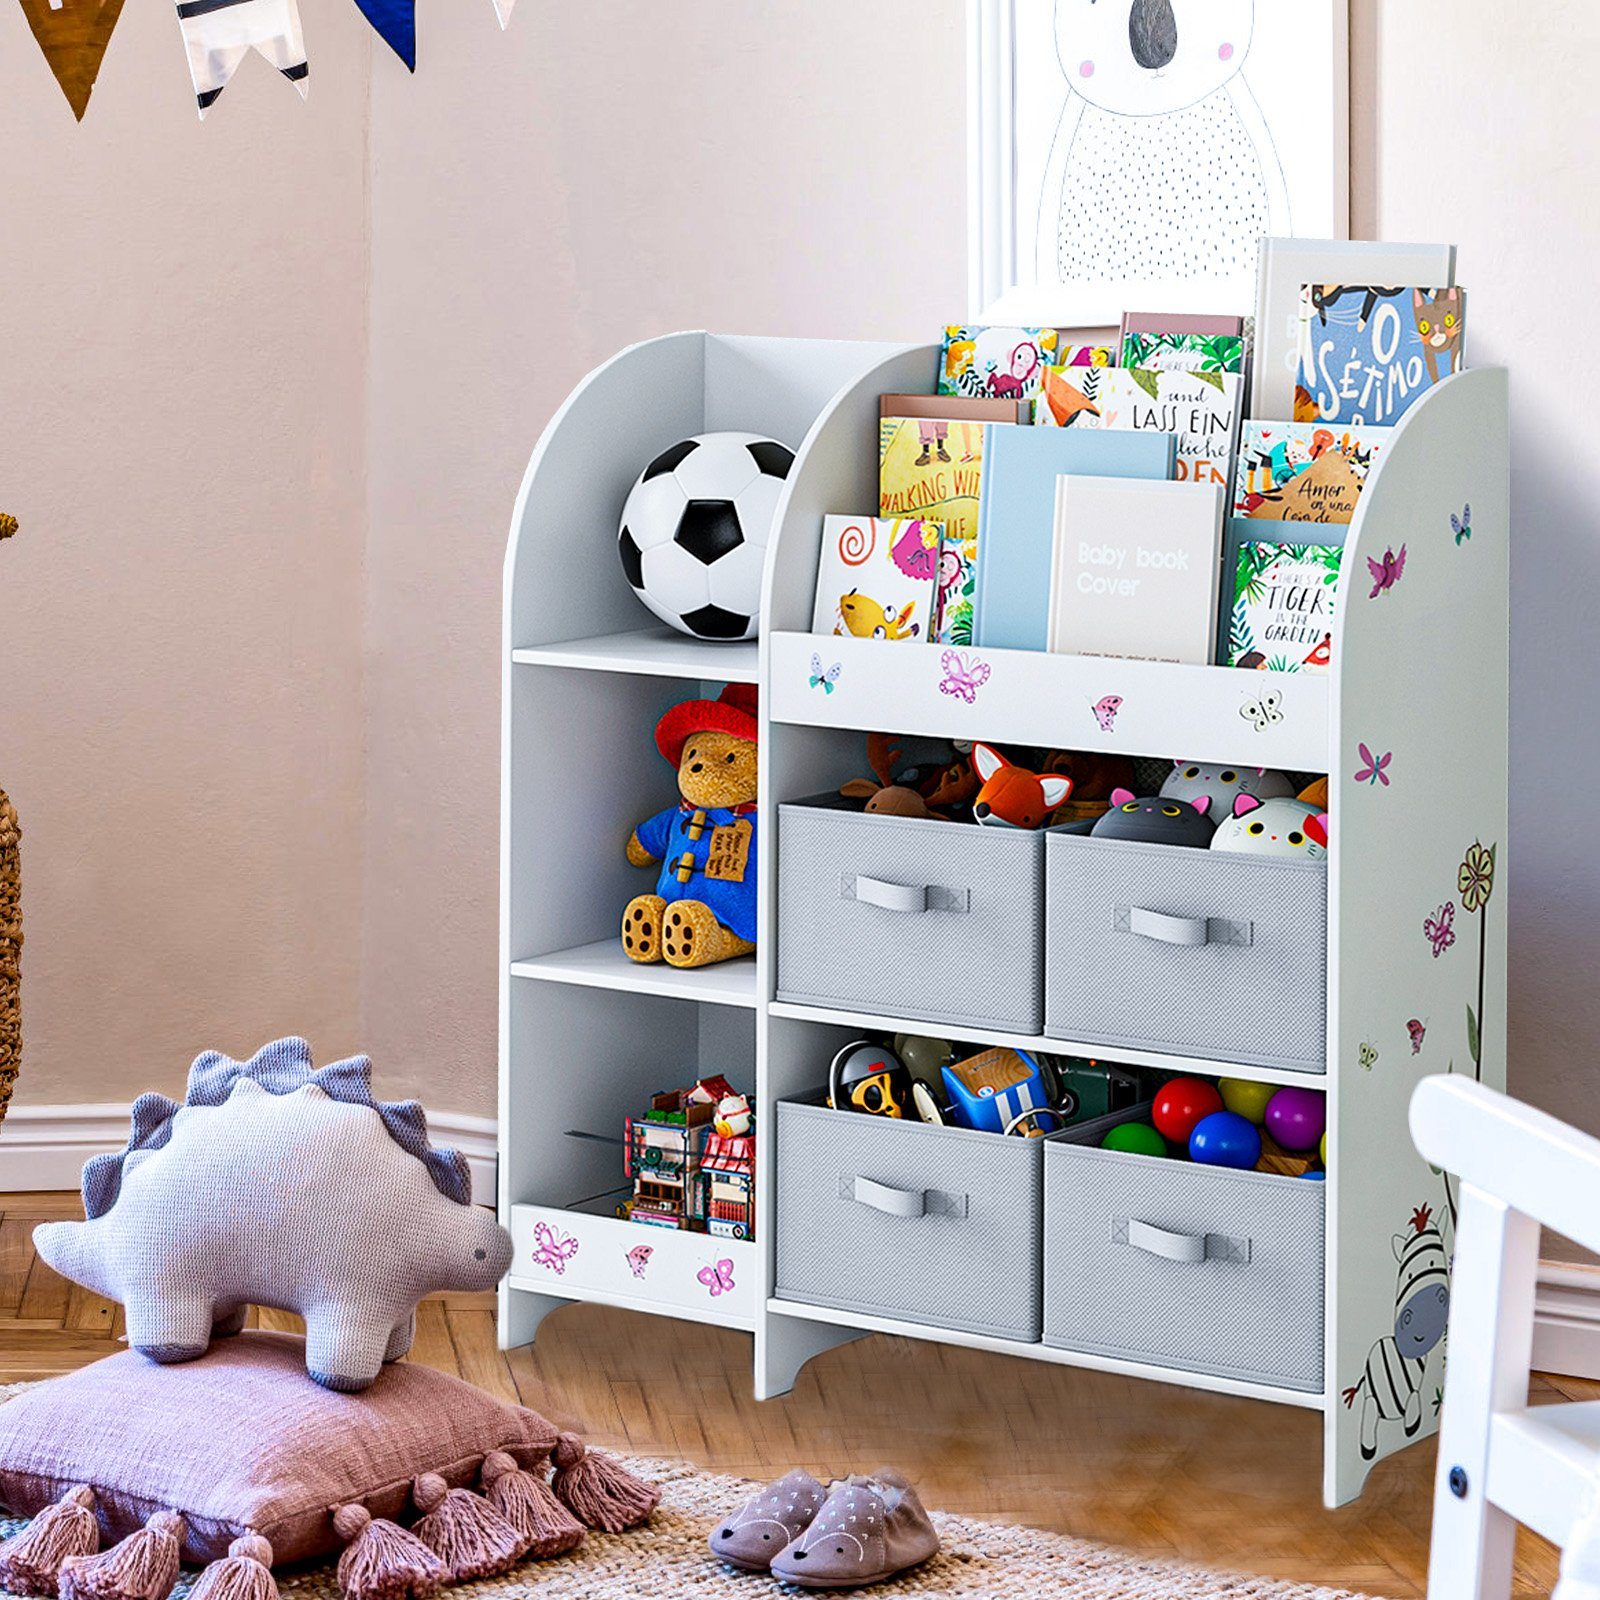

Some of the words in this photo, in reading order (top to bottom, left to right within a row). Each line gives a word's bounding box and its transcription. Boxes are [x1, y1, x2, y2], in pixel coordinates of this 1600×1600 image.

[1371, 302, 1402, 366] O
[1166, 387, 1209, 402] und
[1133, 404, 1178, 432] LASS
[880, 472, 947, 512] WALKING
[1298, 477, 1346, 500] Amor
[1311, 501, 1325, 510] en
[1329, 502, 1354, 511] una
[1077, 542, 1127, 570] Baby
[1136, 546, 1189, 571] book
[1077, 572, 1141, 597] Cover
[1267, 586, 1326, 615] TIGER
[1265, 624, 1321, 644] GARDEN
